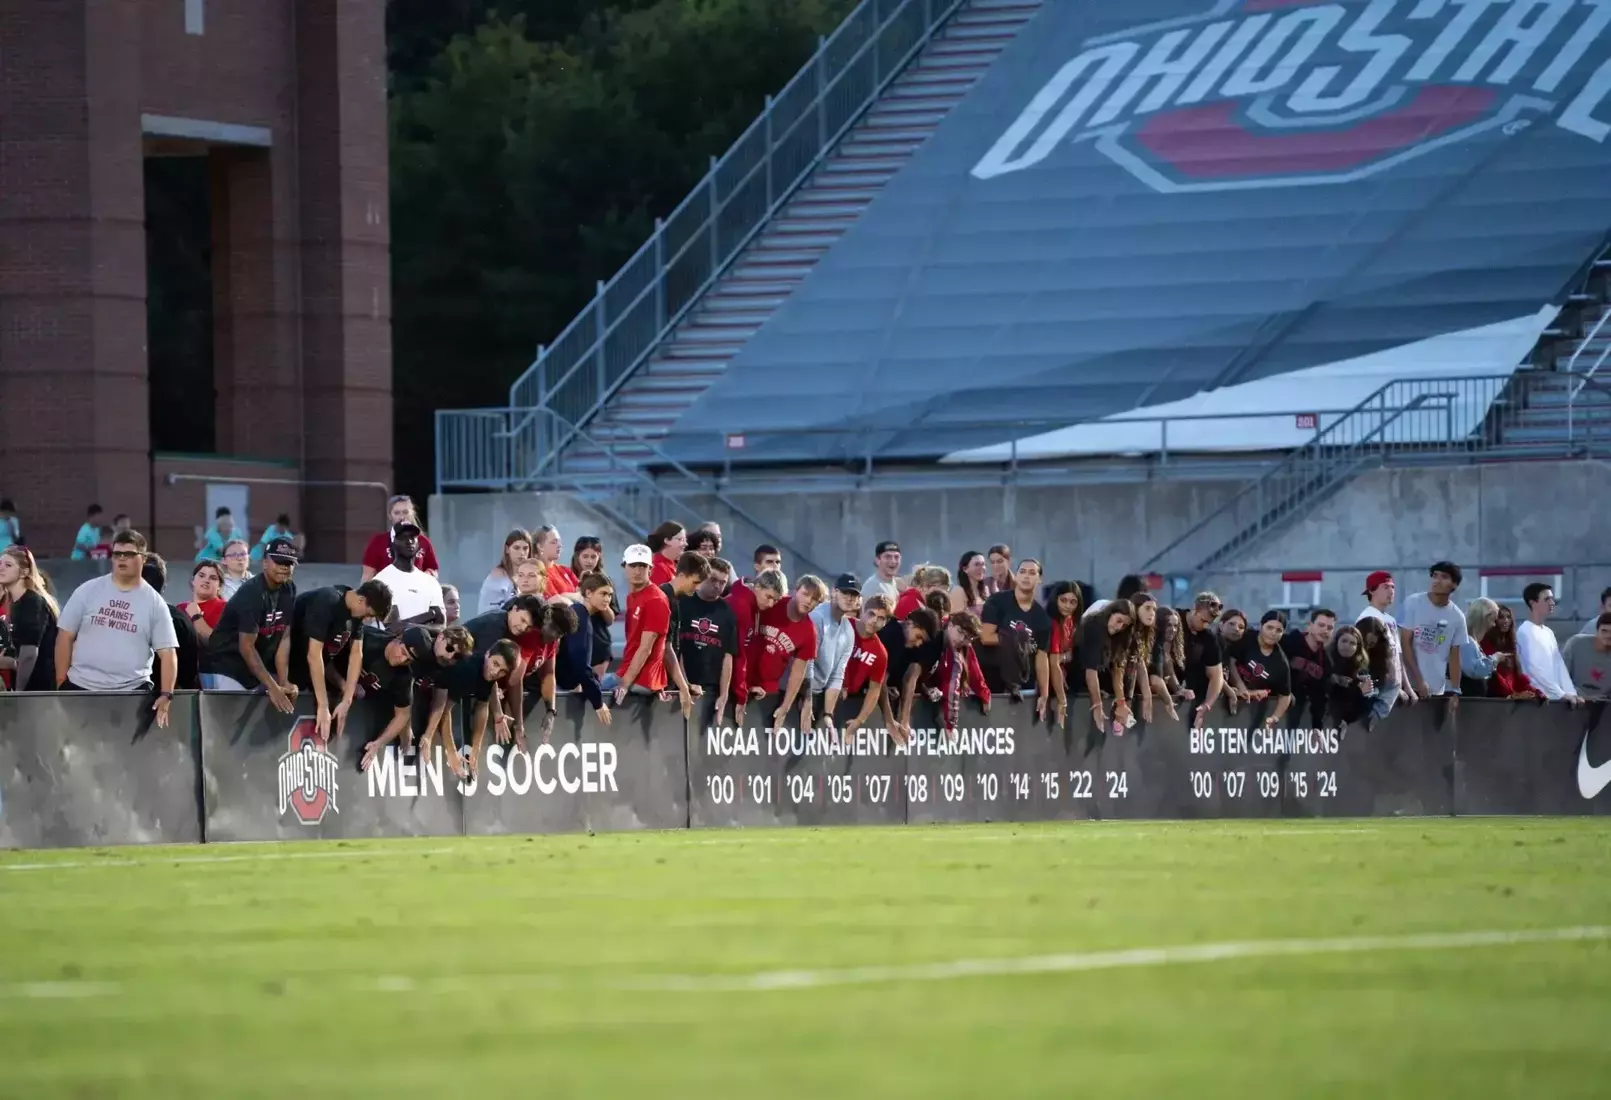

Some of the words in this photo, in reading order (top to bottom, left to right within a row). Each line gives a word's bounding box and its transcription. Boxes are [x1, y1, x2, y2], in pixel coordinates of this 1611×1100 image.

[970, 3, 1347, 179] OHIO
[98, 606, 135, 622] AGAINST
[109, 599, 131, 611] OHIO
[90, 615, 107, 626] THE
[108, 618, 138, 634] WORLD
[853, 646, 877, 666] ME
[706, 727, 759, 756] NCAA
[764, 727, 889, 756] TOURNAMENT
[1189, 727, 1215, 754] BIG
[1218, 727, 1248, 754] TEN
[1251, 727, 1339, 754] CHAMPIONS
[278, 751, 304, 815] OHIO
[303, 744, 340, 815] STATE
[367, 744, 478, 798] MENS
[486, 742, 619, 796] SOCCER
[706, 774, 734, 804] '00
[748, 774, 772, 803] '01
[786, 775, 815, 803] '04
[827, 775, 852, 803] '05
[865, 774, 891, 802] '07
[904, 774, 928, 802] '08
[939, 773, 965, 801] '09
[976, 773, 999, 801] '10
[1010, 772, 1030, 799] '14
[1040, 772, 1060, 799] '15
[1069, 771, 1093, 798] '22
[1105, 771, 1129, 798] '24
[1190, 772, 1213, 798] '00
[1222, 772, 1246, 797] '07
[1256, 772, 1280, 797] '09
[1290, 772, 1308, 797] '15
[1316, 771, 1338, 796] '24
